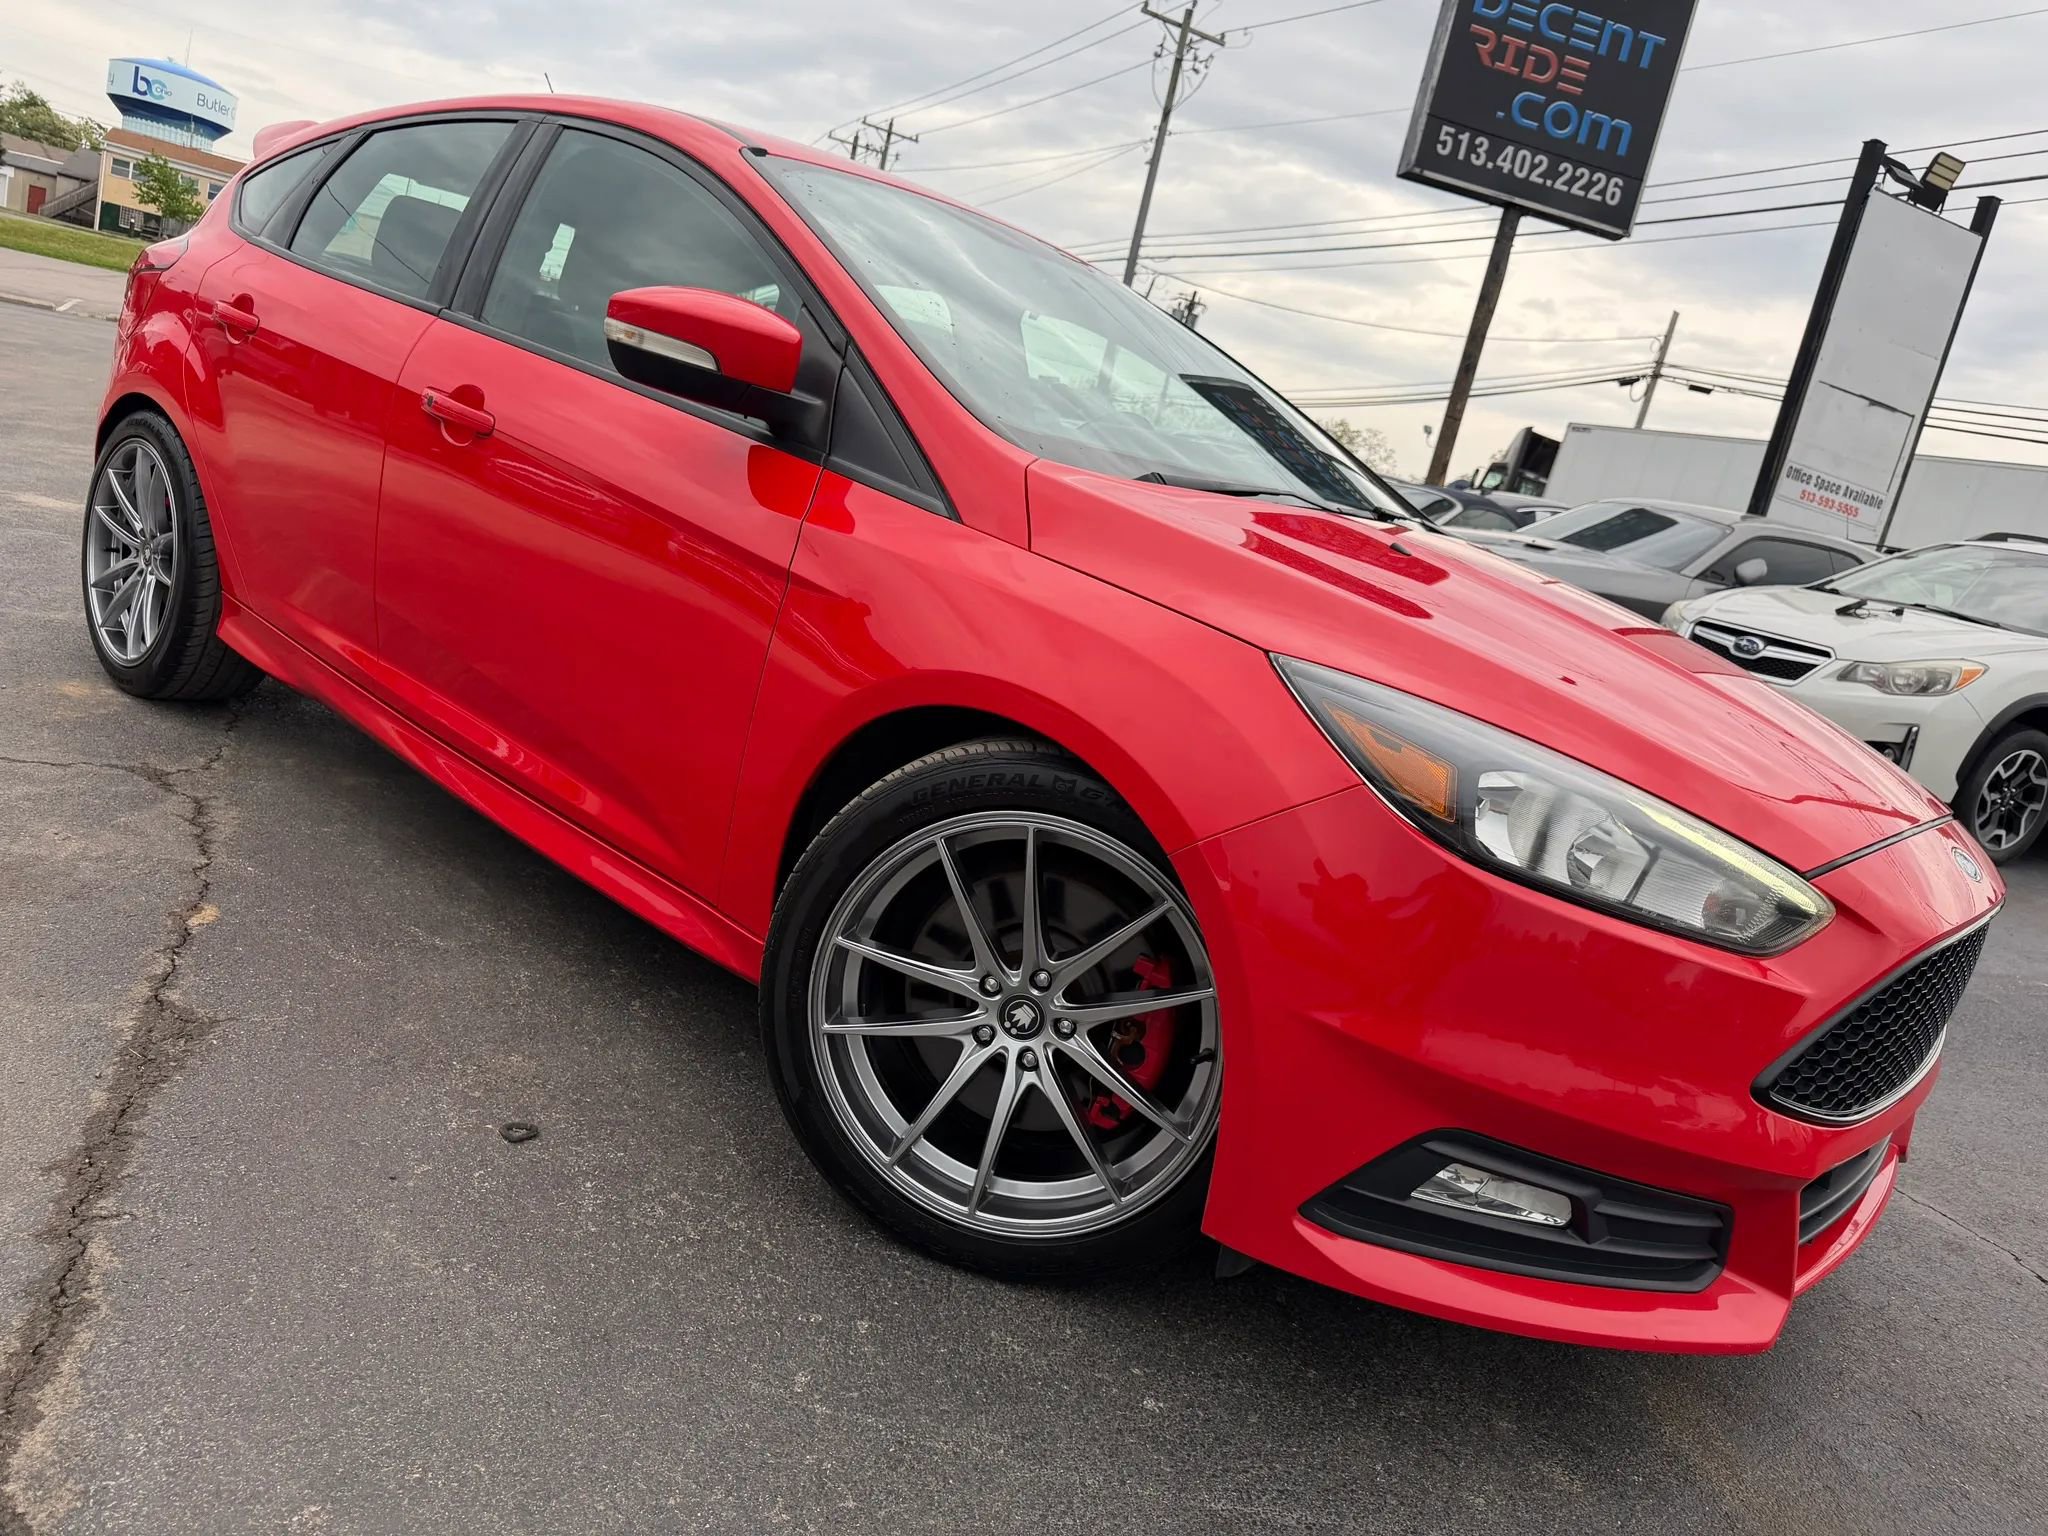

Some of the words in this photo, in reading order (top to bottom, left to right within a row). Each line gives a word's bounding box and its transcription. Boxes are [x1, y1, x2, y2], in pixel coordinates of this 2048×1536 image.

[1470, 24, 1591, 95] RIDE
[196, 92, 230, 116] Butler
[1436, 125, 1624, 206] 513.402.2226
[1814, 475, 1842, 496] Space
[1843, 485, 1884, 510] Available
[912, 772, 1046, 806] GENERAL
